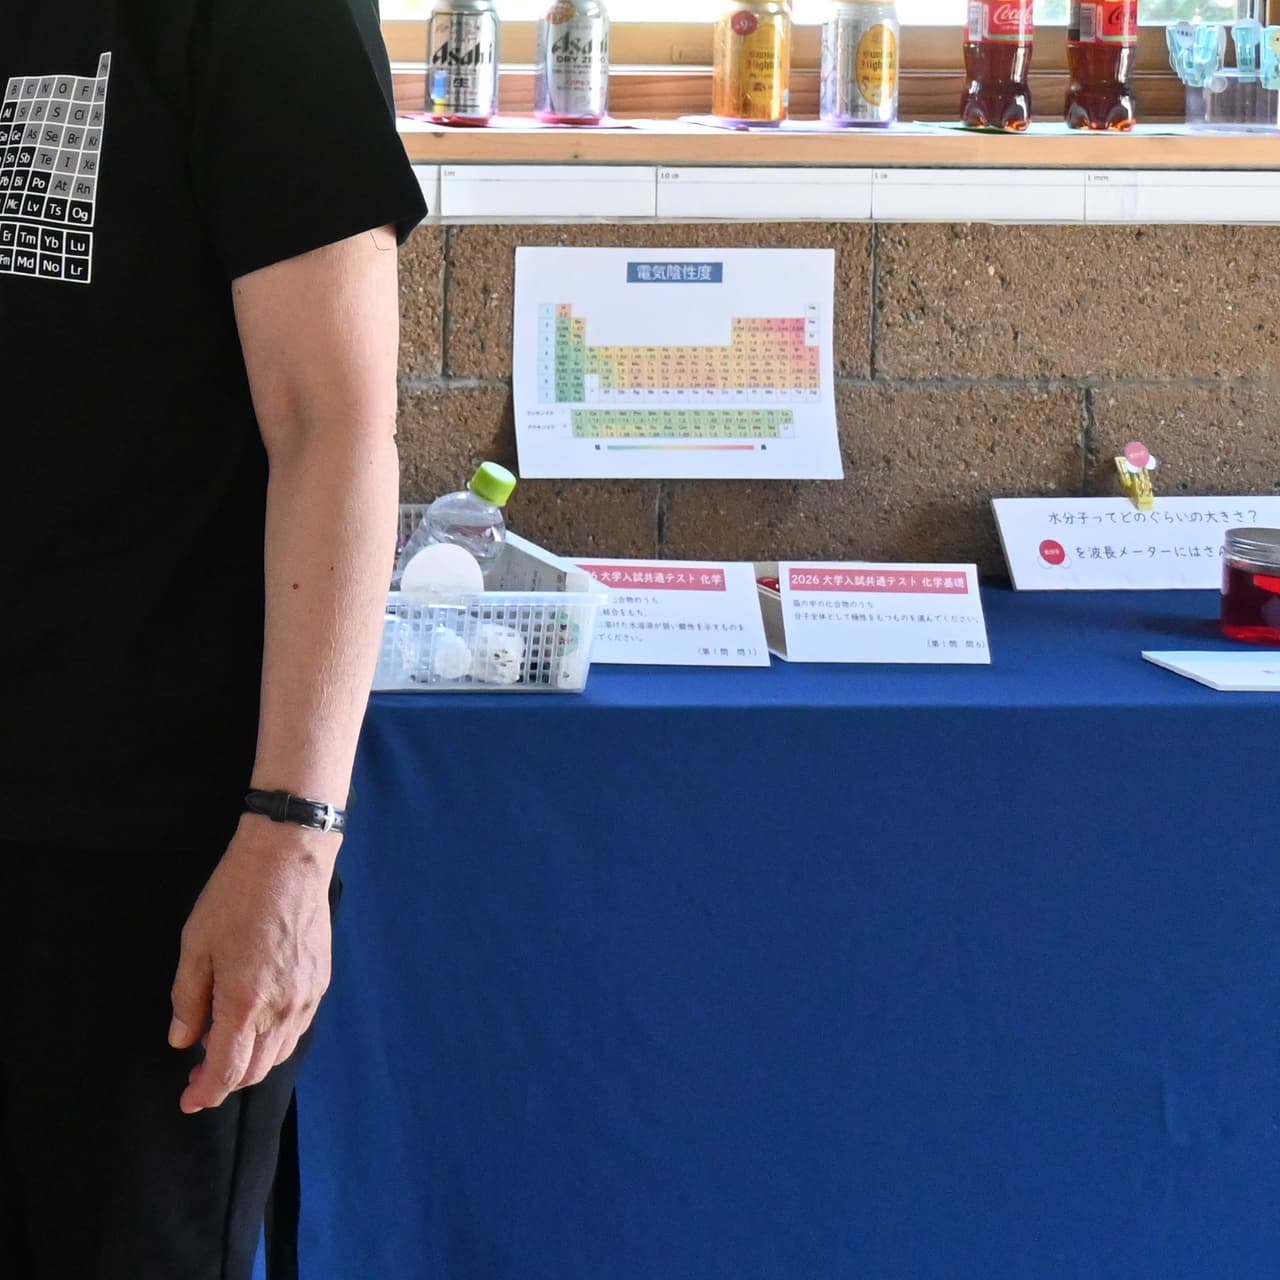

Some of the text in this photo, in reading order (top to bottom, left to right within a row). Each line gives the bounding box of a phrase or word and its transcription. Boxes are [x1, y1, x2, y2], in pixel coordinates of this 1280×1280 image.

[32, 178, 45, 188] Po
[28, 201, 39, 211] Lv
[50, 204, 61, 215] Ts
[73, 208, 88, 221] Og
[45, 236, 58, 248] Yb
[71, 240, 85, 251] Lu
[16, 256, 35, 269] Md
[637, 264, 712, 280] 電気陰性度
[701, 575, 721, 585] 化学
[792, 575, 819, 585] 2026
